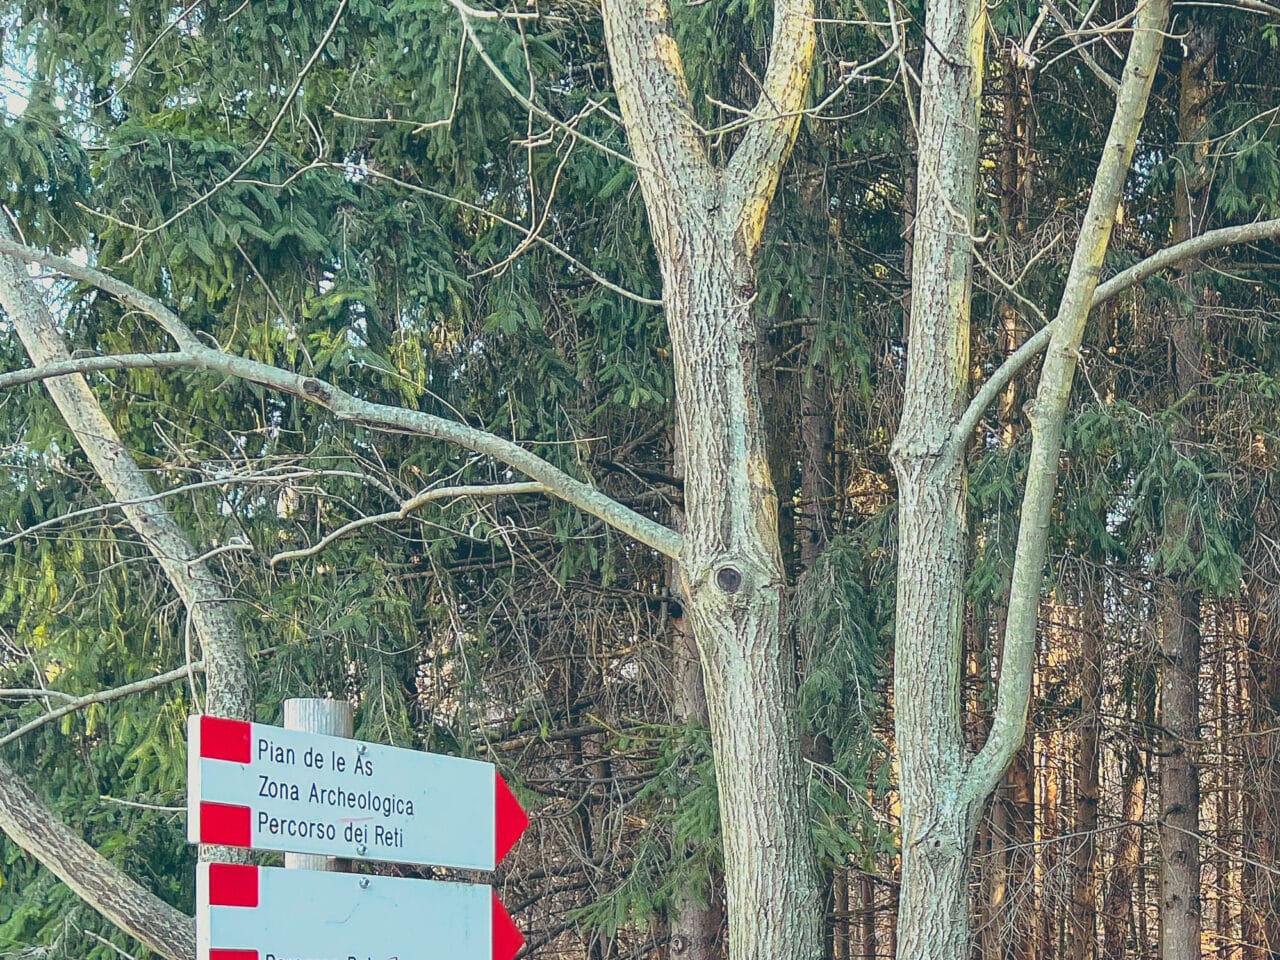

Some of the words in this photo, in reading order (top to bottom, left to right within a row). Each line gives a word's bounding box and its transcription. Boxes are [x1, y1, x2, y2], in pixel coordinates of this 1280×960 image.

[258, 738, 295, 765] Pian
[304, 746, 324, 769] de
[332, 751, 346, 773] le
[258, 775, 300, 801] Zona
[308, 782, 414, 817] Archeologica
[258, 811, 336, 840] Percorso
[344, 822, 368, 844] dei
[375, 825, 403, 848] Reti
